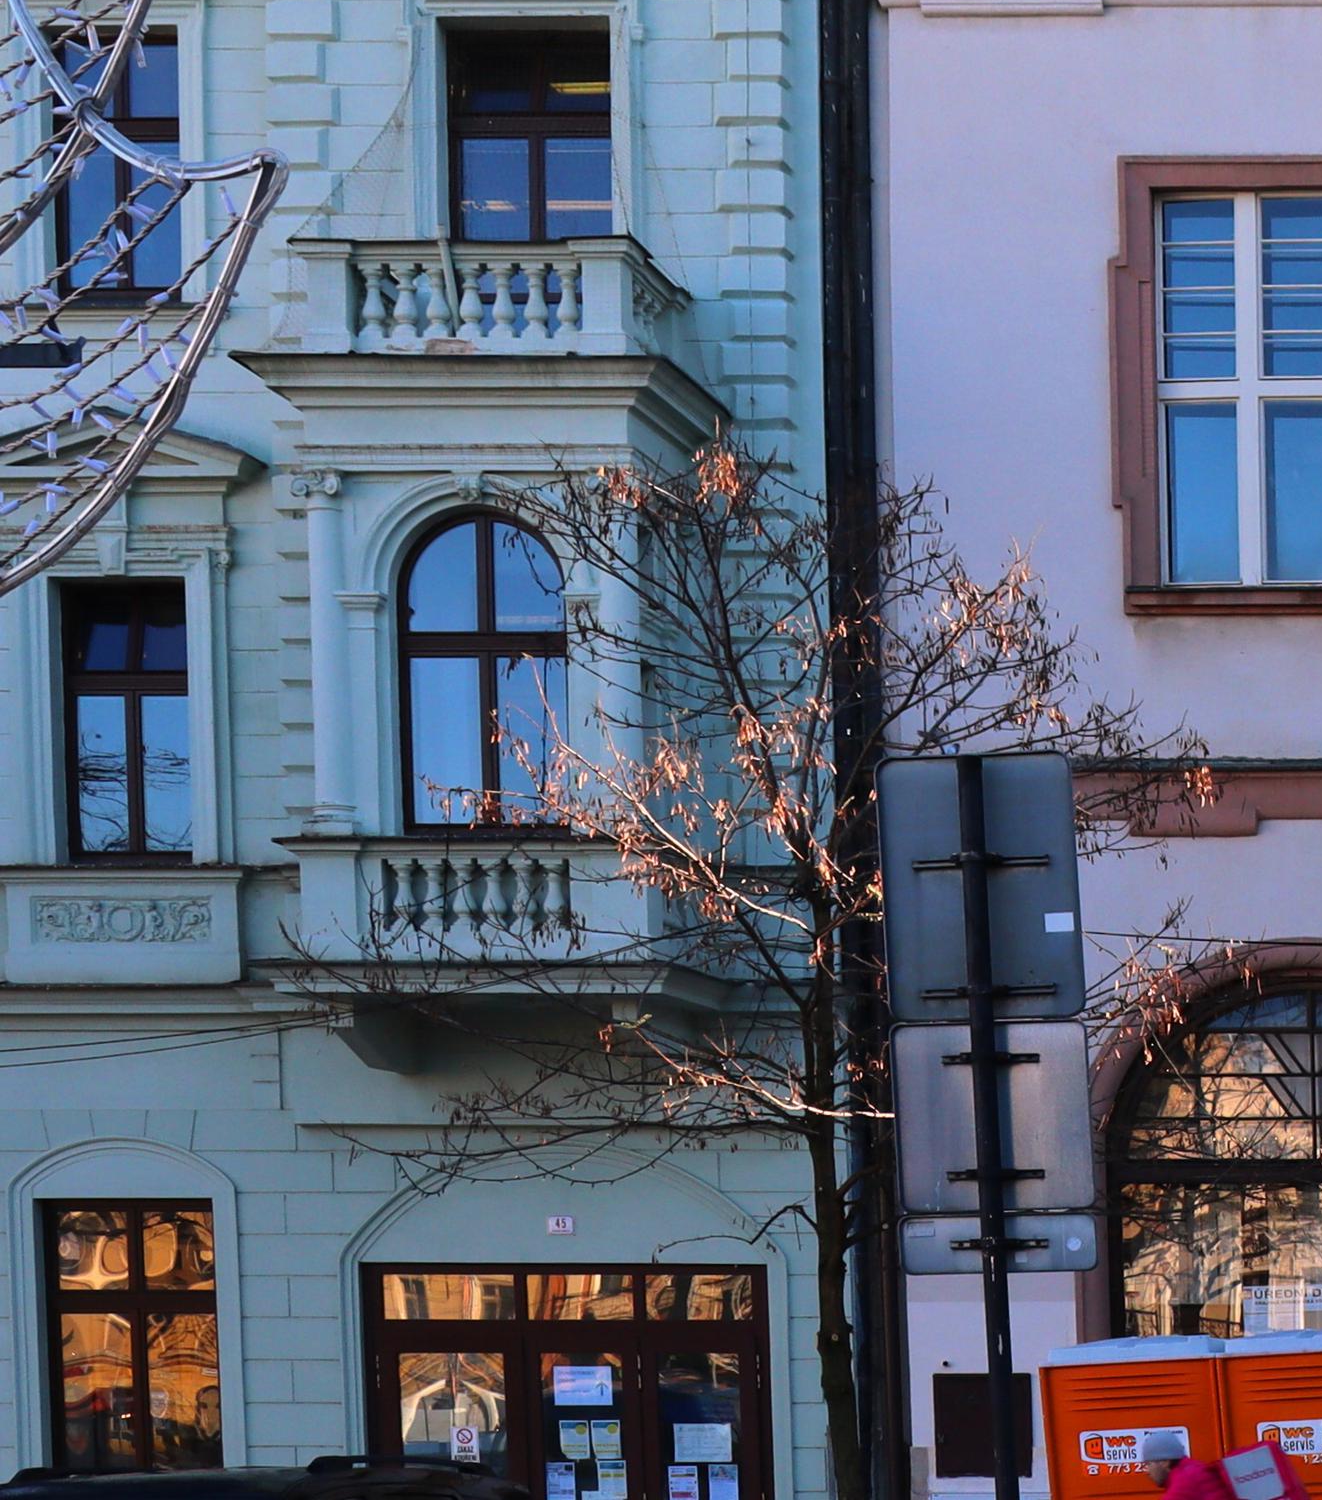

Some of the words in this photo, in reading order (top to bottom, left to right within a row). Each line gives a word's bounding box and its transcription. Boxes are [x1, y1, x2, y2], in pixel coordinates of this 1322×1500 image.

[555, 1218, 567, 1229] 45
[1282, 1426, 1315, 1439] WC
[1104, 1434, 1137, 1447] WC
[1283, 1438, 1315, 1452] servis
[1106, 1446, 1137, 1461] servis
[1107, 1463, 1131, 1474] 773
